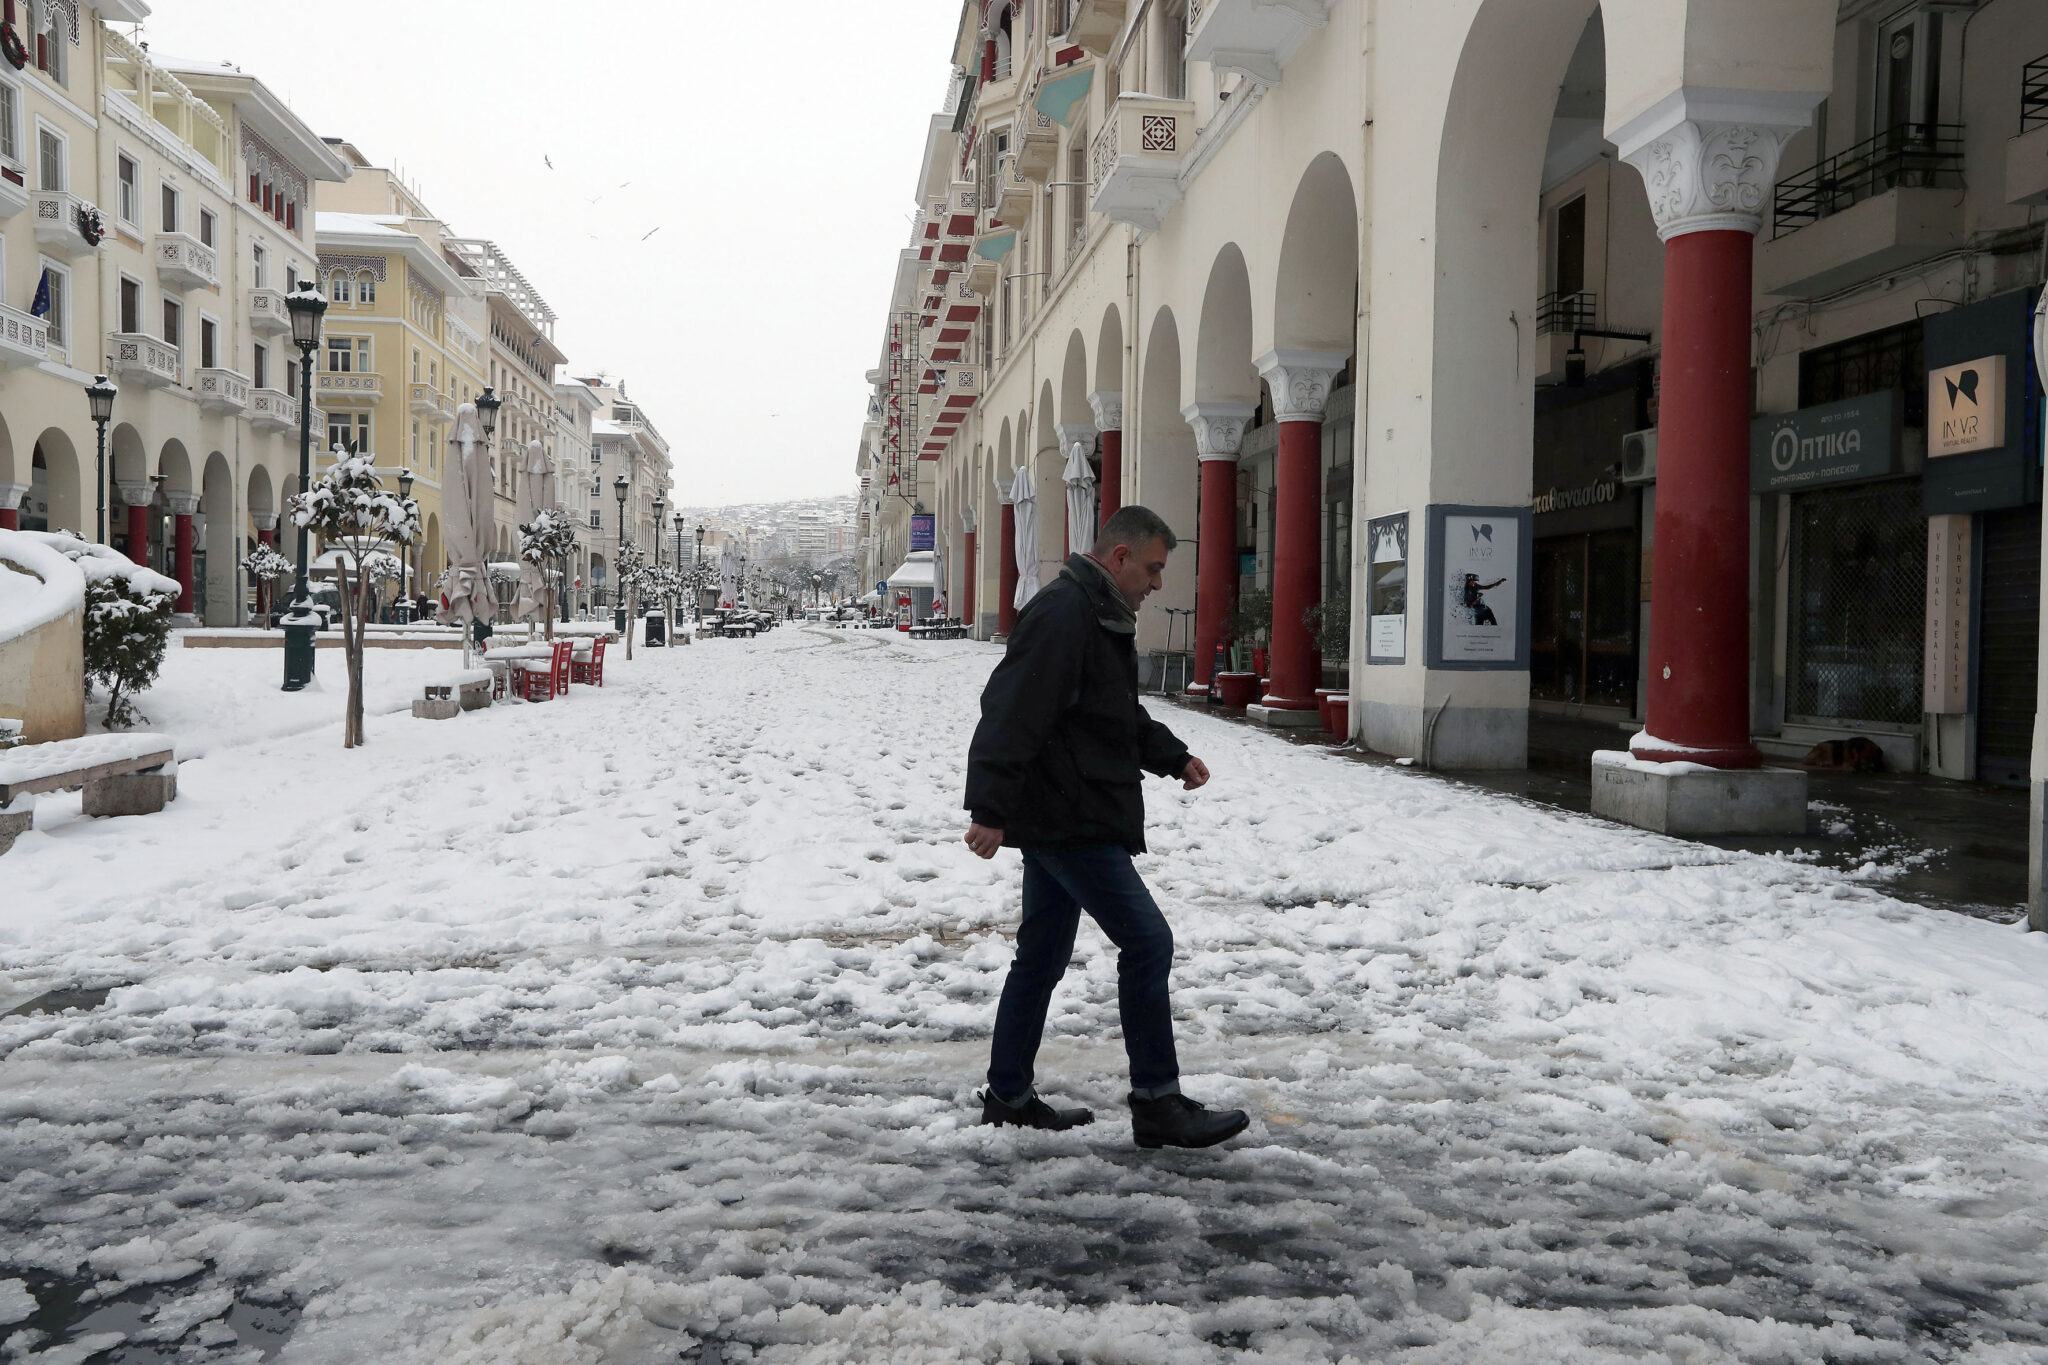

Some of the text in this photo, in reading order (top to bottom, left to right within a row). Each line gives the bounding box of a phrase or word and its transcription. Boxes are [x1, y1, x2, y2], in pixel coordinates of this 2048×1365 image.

[1943, 415, 1979, 439] IN VR
[1943, 435, 1978, 448] VIRTUAL REALITY
[1955, 533, 1963, 607] VIRTUAL
